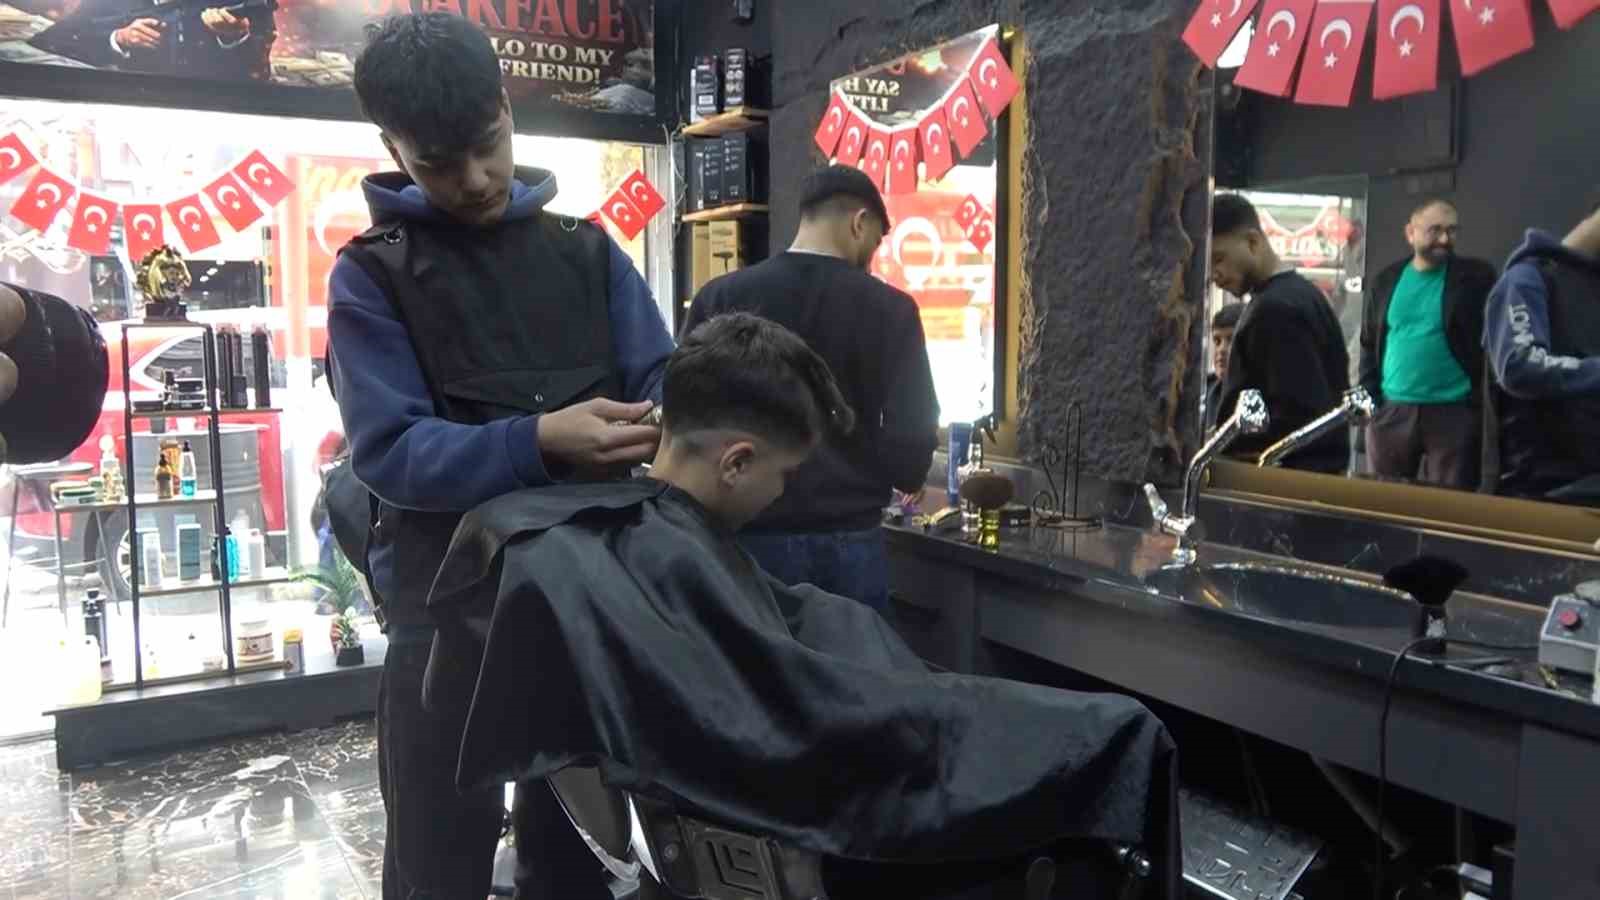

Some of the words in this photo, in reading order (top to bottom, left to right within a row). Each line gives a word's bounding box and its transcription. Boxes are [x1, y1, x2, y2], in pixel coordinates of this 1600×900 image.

[489, 37, 526, 57] LO
[531, 41, 567, 61] TO
[575, 46, 614, 66] MY
[498, 58, 601, 84] FRIEND!
